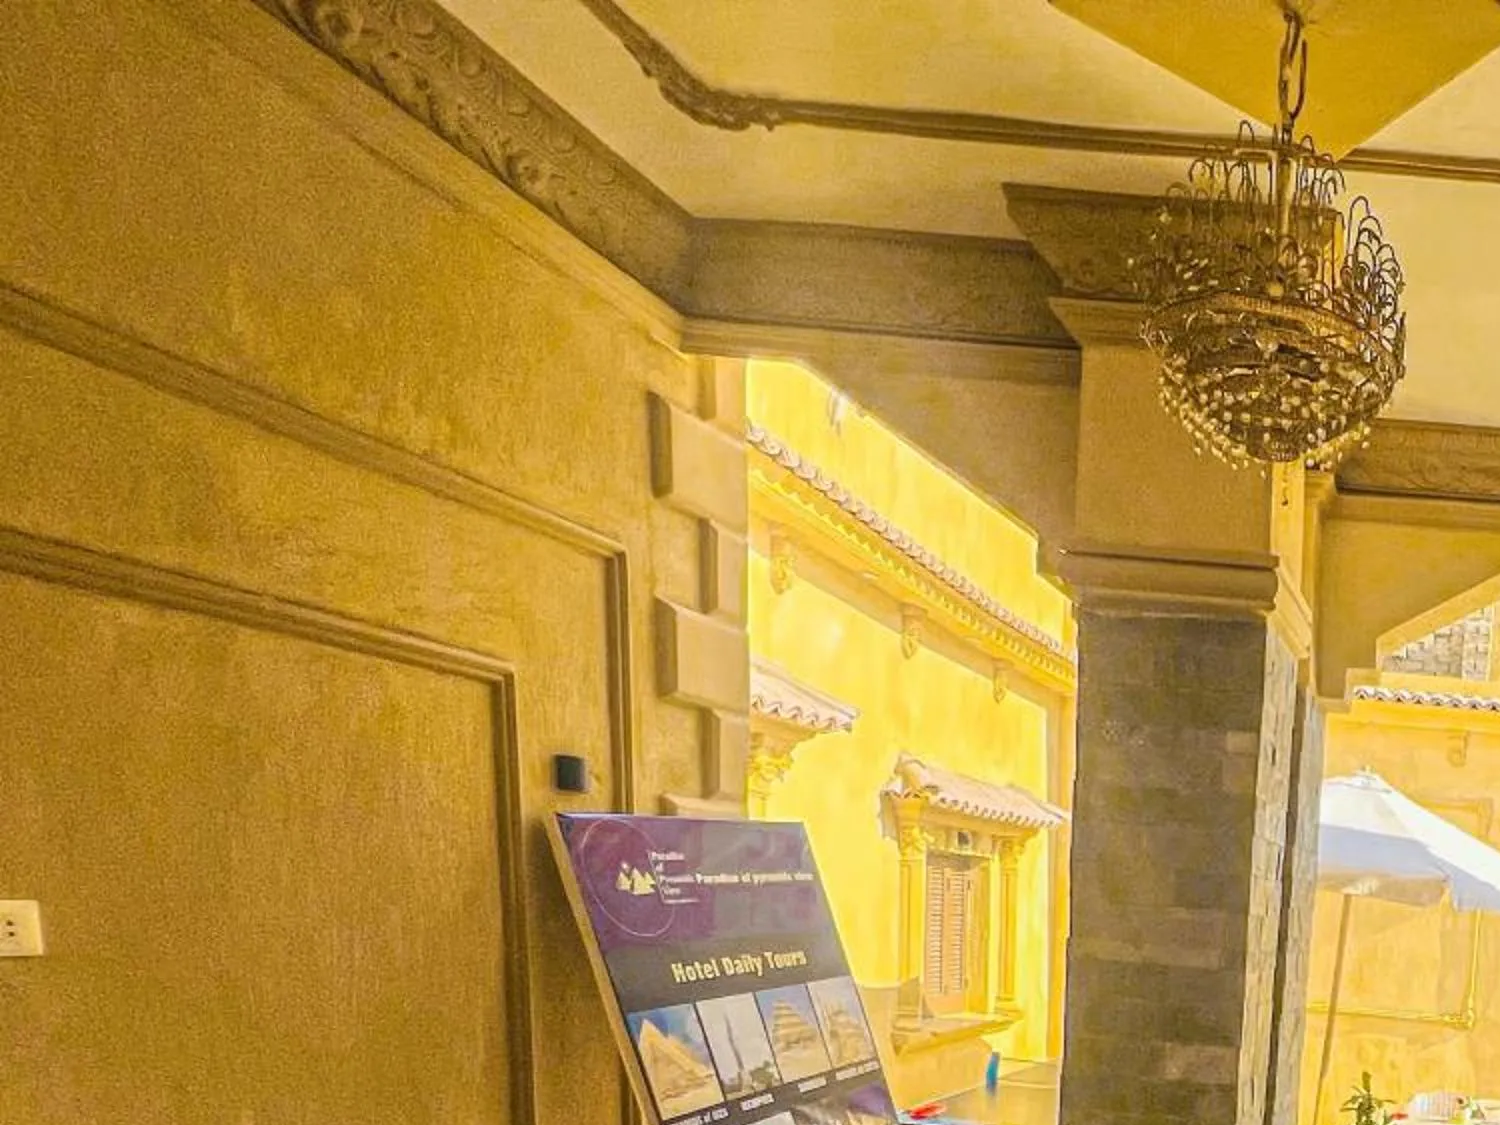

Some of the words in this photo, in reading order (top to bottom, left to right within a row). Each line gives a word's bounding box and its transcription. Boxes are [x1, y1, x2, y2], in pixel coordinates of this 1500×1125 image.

[671, 957, 721, 983] Hotel
[720, 954, 763, 977] Daily
[763, 950, 807, 969] Tours
